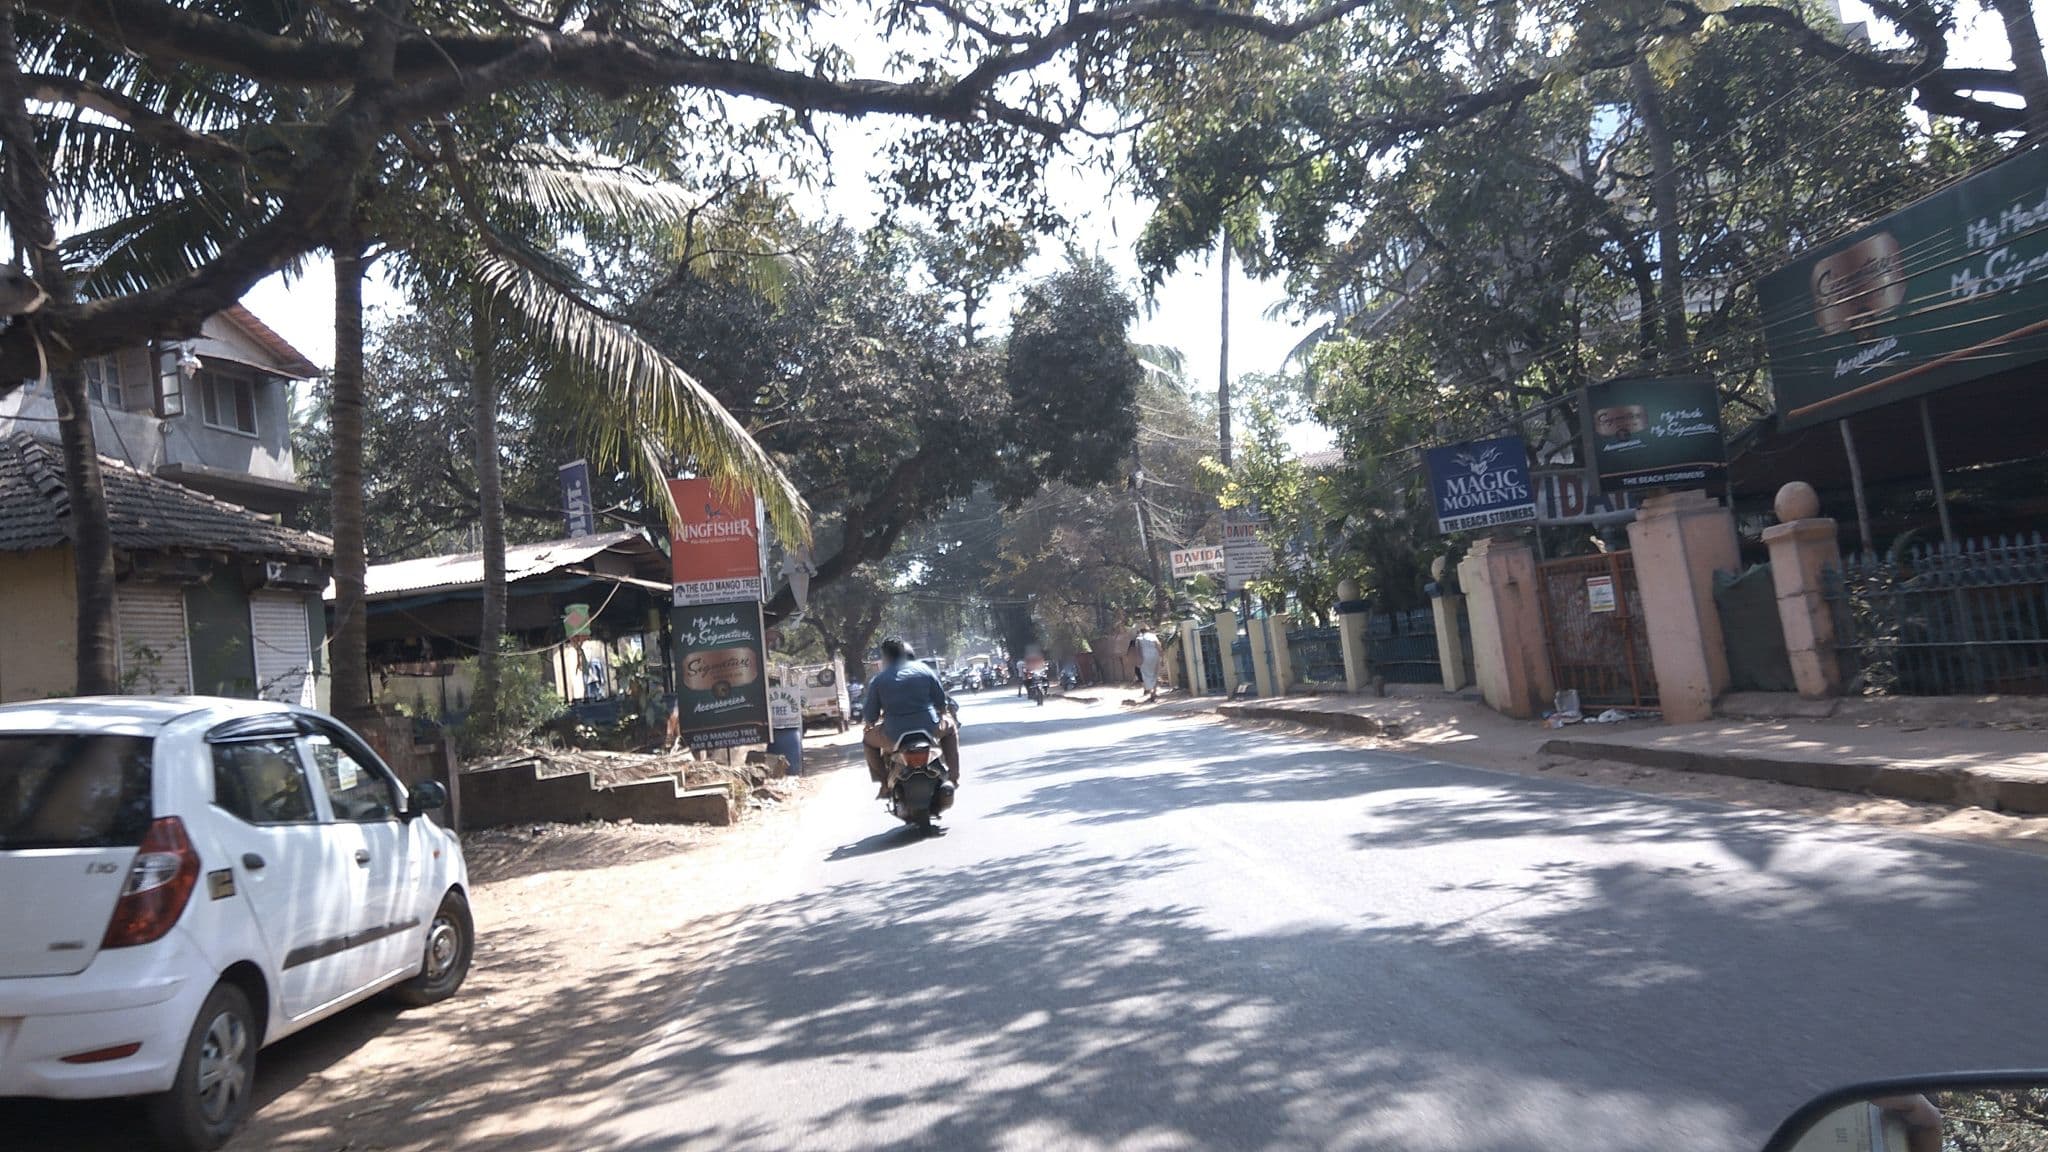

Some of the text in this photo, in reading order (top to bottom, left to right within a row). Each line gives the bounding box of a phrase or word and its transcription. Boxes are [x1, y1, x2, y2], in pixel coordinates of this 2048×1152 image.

[1967, 216, 1998, 255] My
[1950, 267, 1981, 298] My
[1661, 408, 1703, 423] My Mark
[1650, 425, 1666, 437] My
[1446, 469, 1520, 497] MAGIC
[1639, 475, 1664, 484] BEACH
[1443, 484, 1528, 512] MOMENTS
[1443, 506, 1535, 531] THE BEACH STORMERS
[674, 519, 754, 542] KINGFISHER
[686, 578, 760, 593] THE OLD MANGO TREE
[692, 612, 738, 631] My Mark
[681, 628, 752, 646] My Signature
[772, 706, 787, 716] TREE
[710, 730, 739, 740] MANGO
[740, 728, 757, 736] TREE
[714, 736, 761, 747] RESTAURANT
